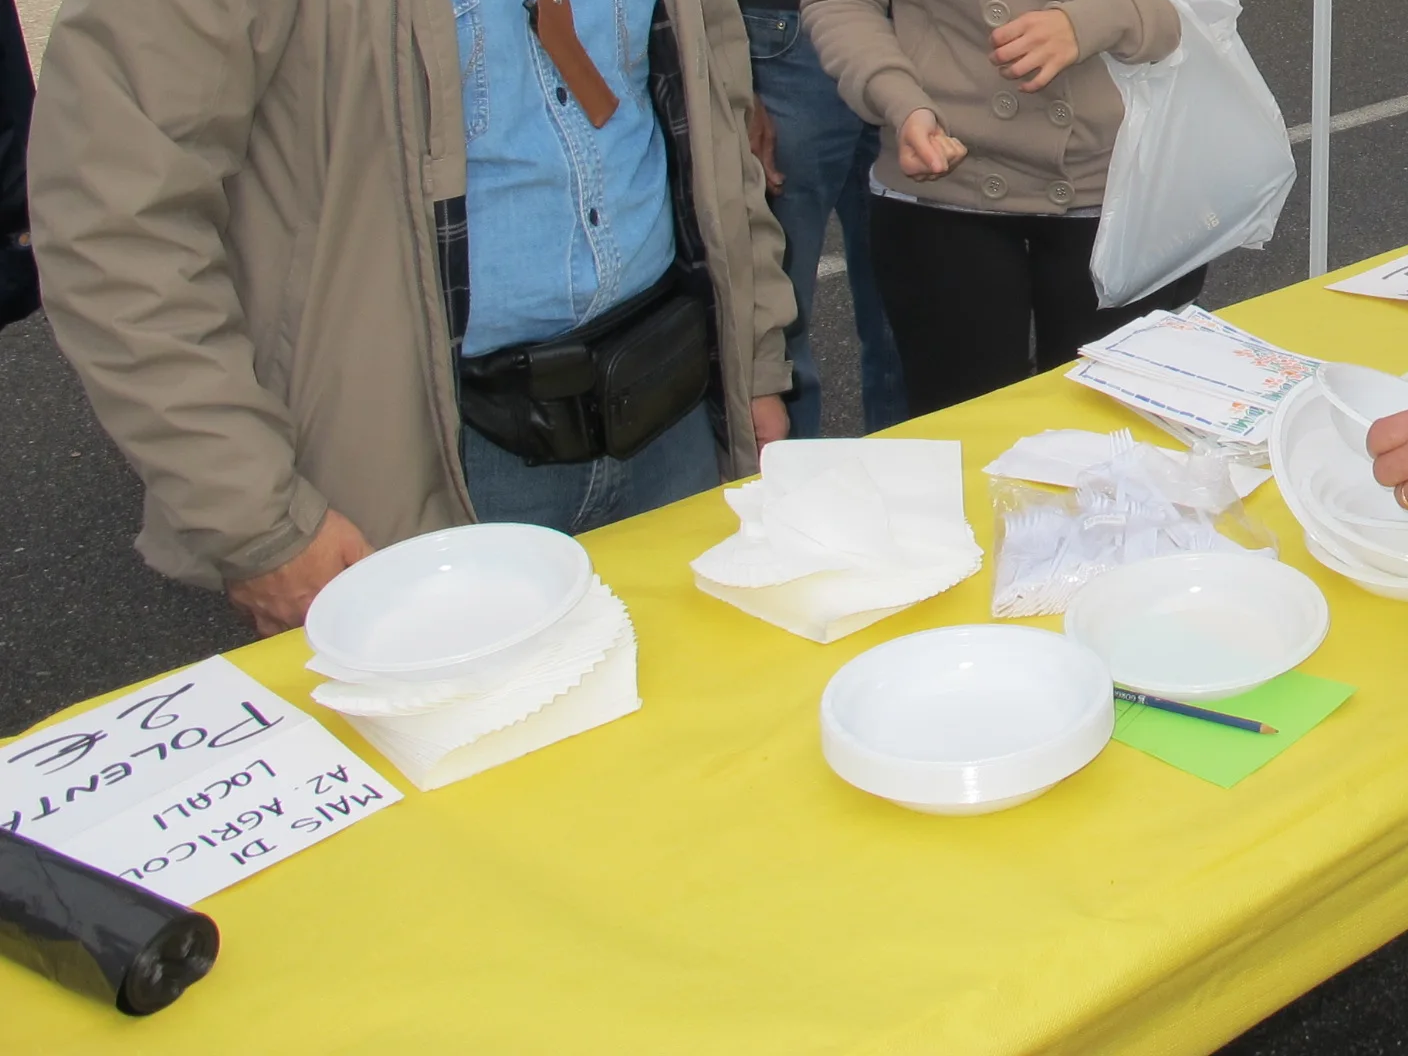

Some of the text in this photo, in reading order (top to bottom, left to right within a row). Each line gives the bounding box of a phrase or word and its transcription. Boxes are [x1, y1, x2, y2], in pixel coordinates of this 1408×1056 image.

[116, 682, 195, 730] 2
[0, 701, 285, 834] POLENTA
[152, 758, 277, 831] LOCALI
[118, 796, 286, 881] AGRICOL
[229, 782, 384, 867] MAIS DI
